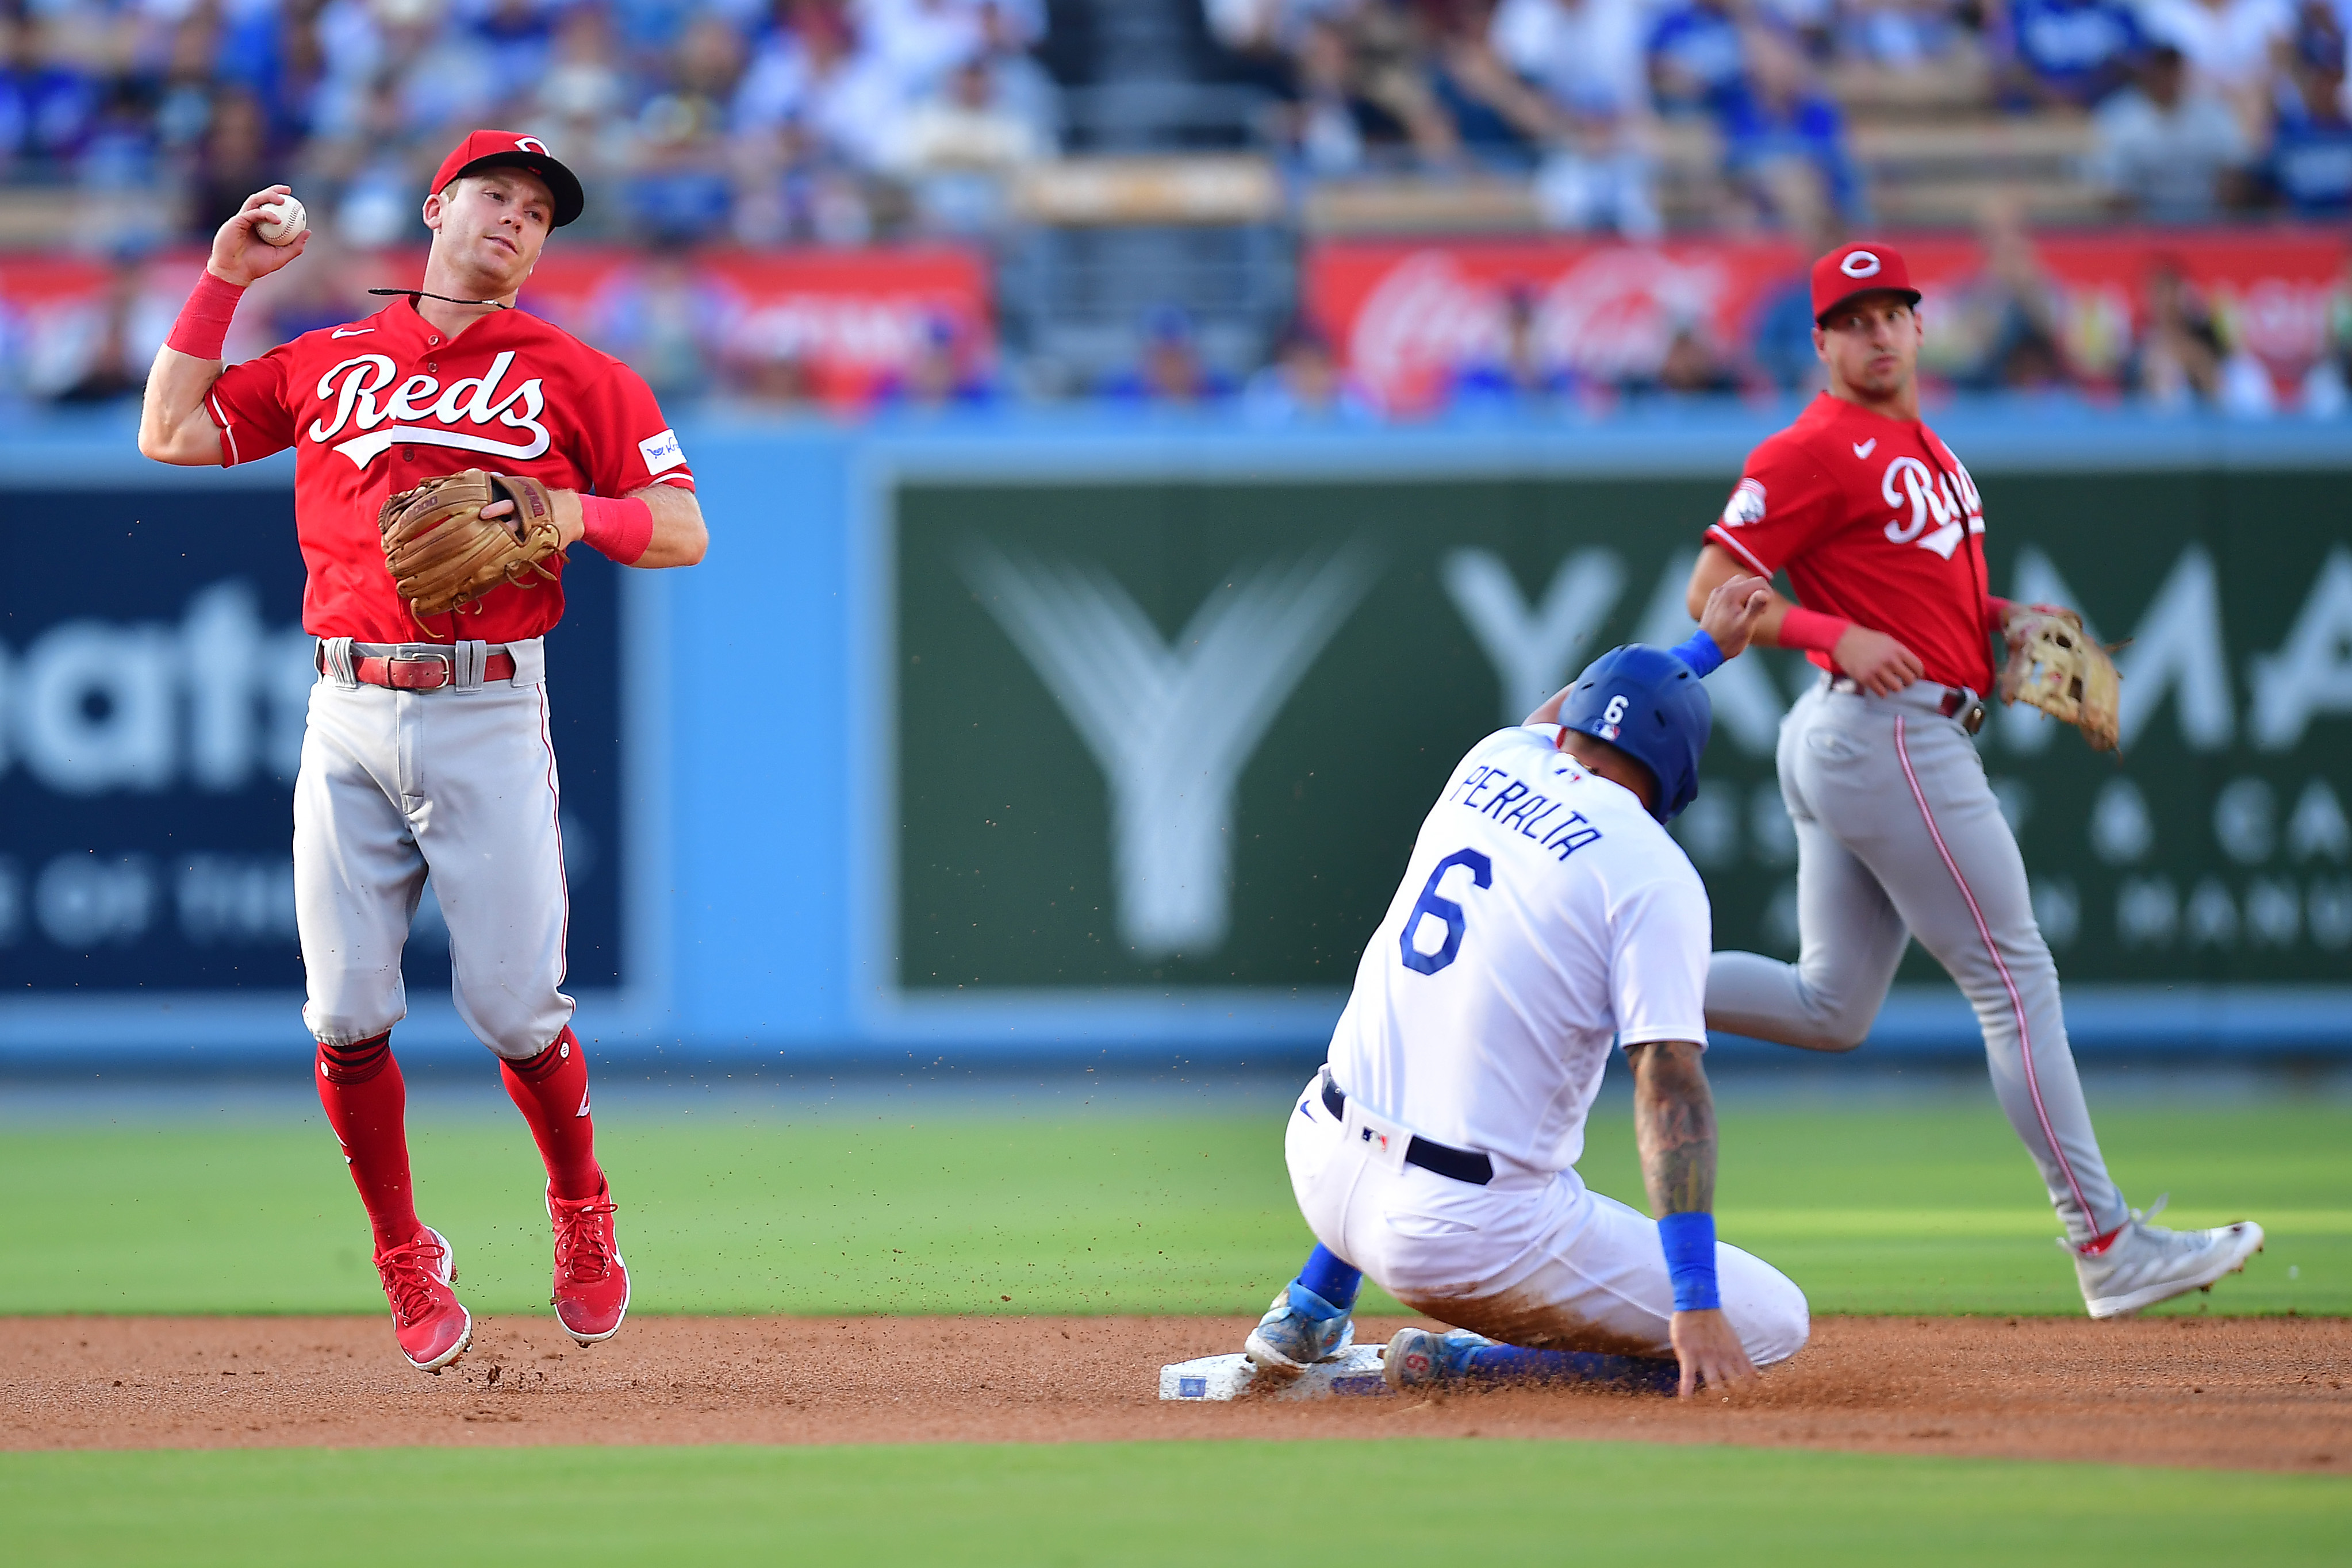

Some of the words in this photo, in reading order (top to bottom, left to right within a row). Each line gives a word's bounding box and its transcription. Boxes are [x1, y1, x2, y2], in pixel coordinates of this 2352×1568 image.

[1840, 250, 1881, 279] C
[309, 351, 550, 460] Reds
[1603, 694, 1629, 725] 6
[1449, 766, 1603, 862] PERALTA
[1399, 847, 1493, 976] 6
